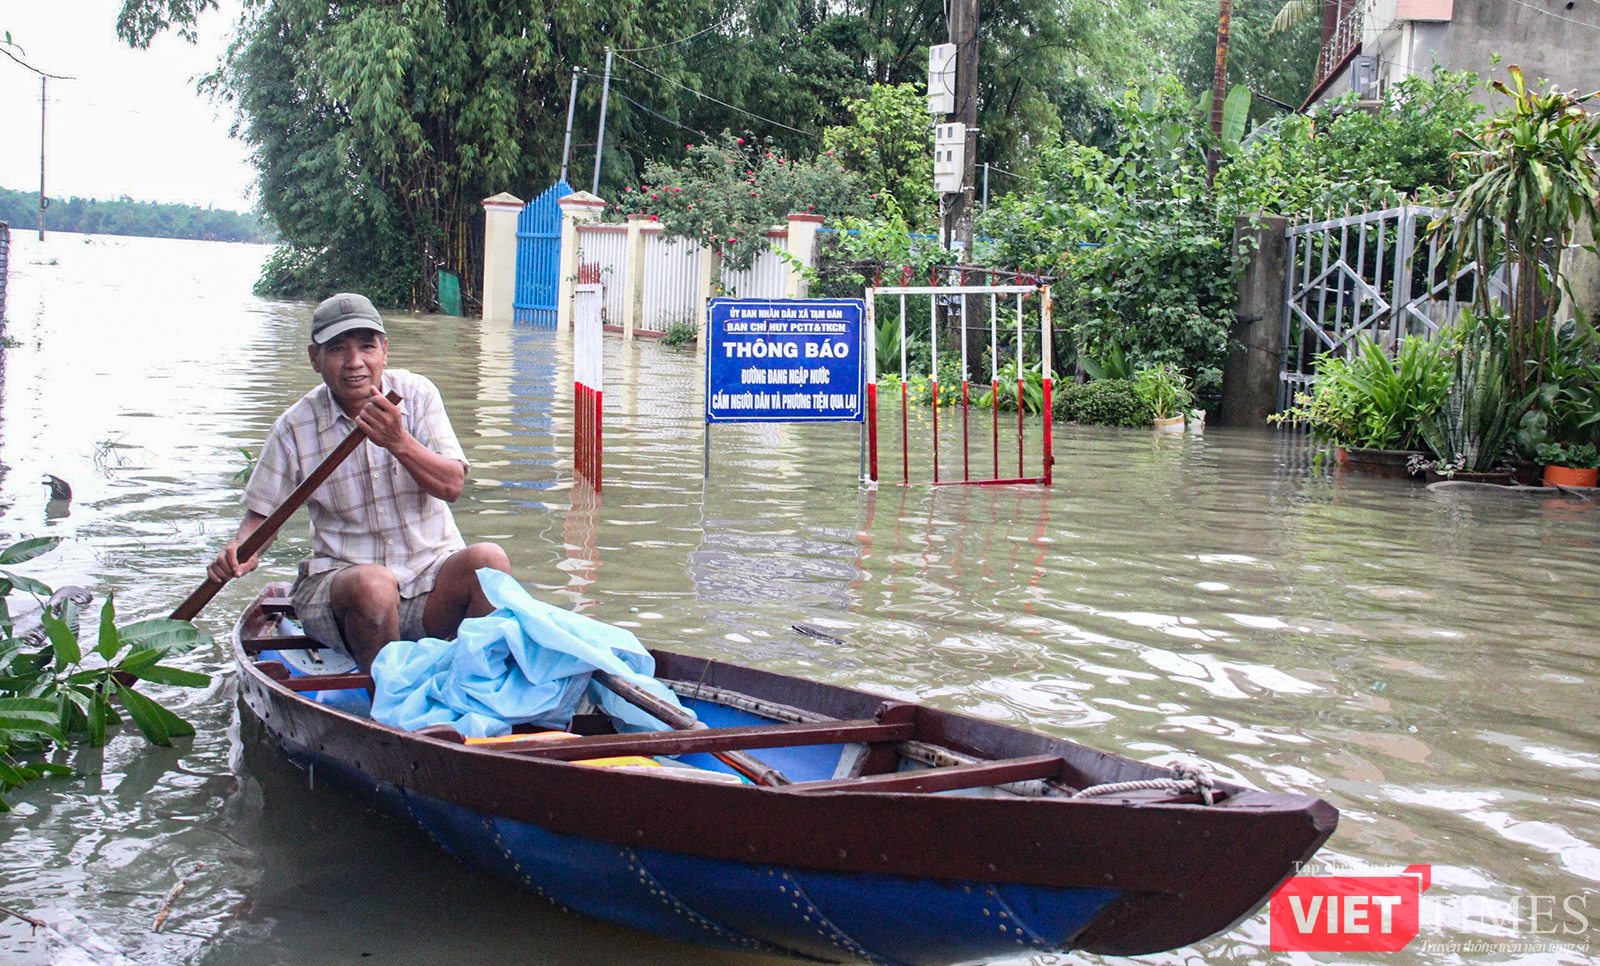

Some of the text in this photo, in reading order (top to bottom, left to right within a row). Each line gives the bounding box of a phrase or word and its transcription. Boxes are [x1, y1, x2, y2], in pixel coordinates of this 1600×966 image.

[741, 309, 756, 318] BAN
[759, 308, 779, 318] NHÂN
[781, 308, 797, 318] DÂN
[798, 308, 809, 318] XÃ
[827, 309, 842, 318] ĐÀN
[727, 323, 747, 331] BAN
[769, 323, 788, 331] HUY
[791, 323, 846, 331] PCTT&TKCN
[723, 338, 849, 358] THÔNG BÁO
[741, 366, 830, 387] ĐƯỜNG ĐANG NGẬP NƯỚC
[712, 389, 856, 412] CẤM NGƯỜI DÂN VÀ PHƯƠNG TIỆN QUA LẠI
